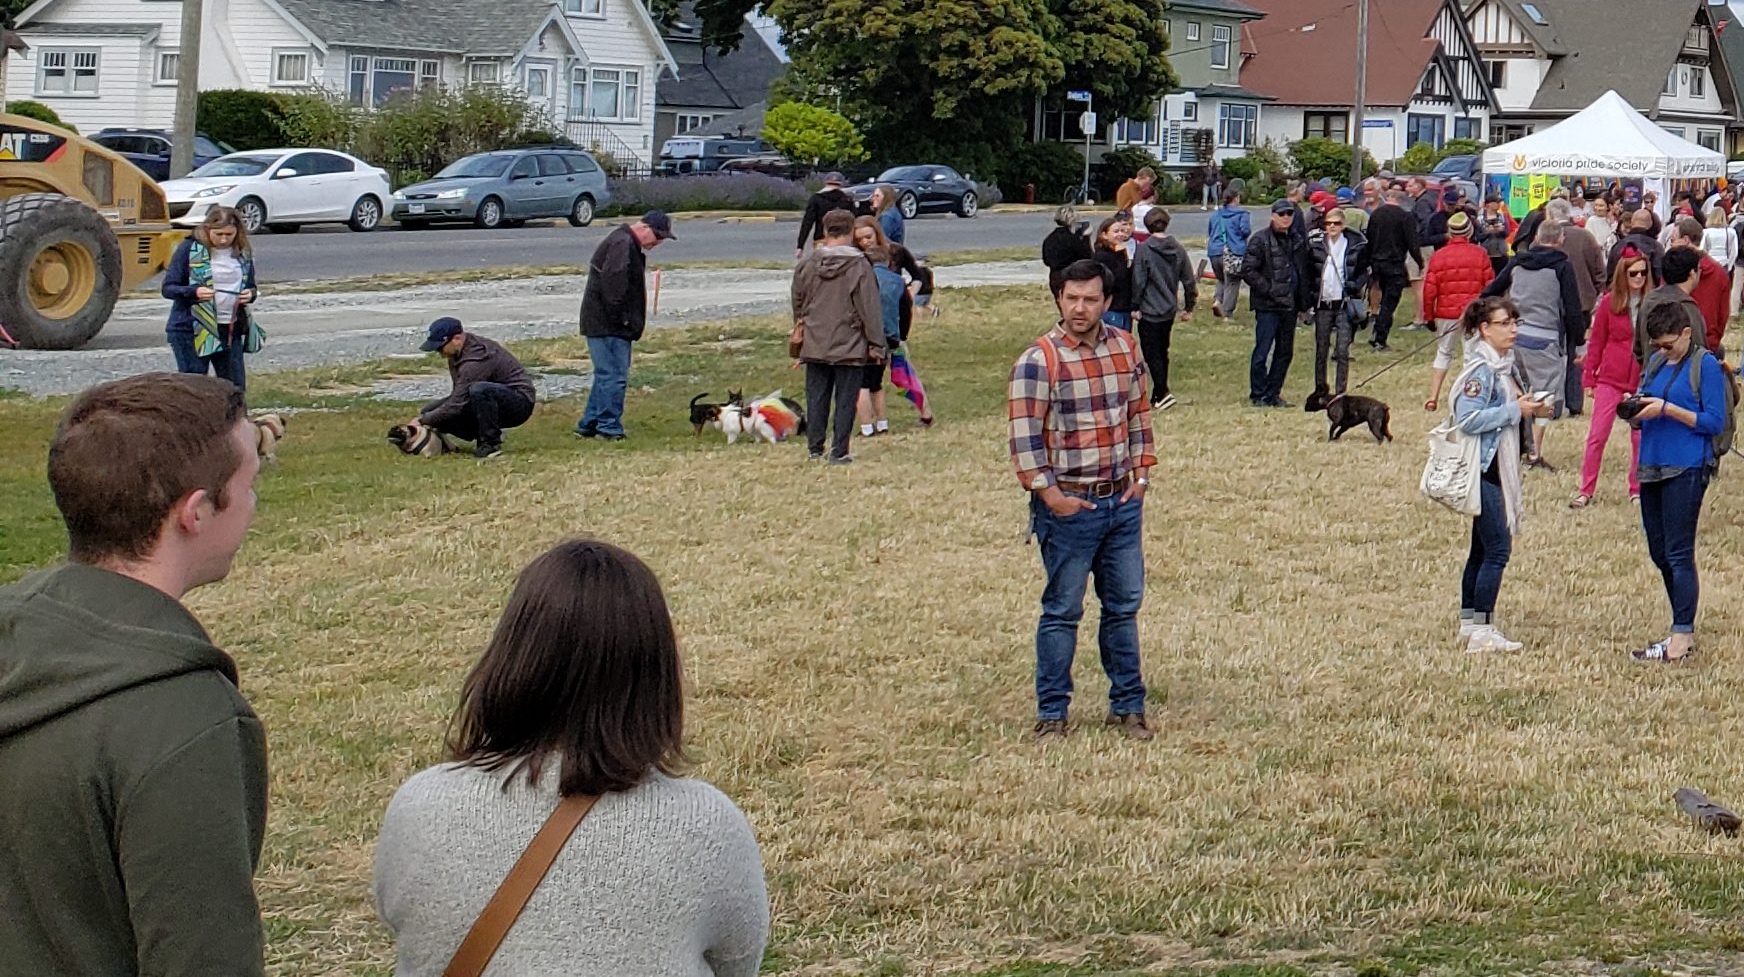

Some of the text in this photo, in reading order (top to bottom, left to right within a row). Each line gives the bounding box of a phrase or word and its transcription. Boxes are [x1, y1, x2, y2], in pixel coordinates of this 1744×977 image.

[0, 133, 26, 160] AT
[1533, 158, 1648, 171] victoria pride society
